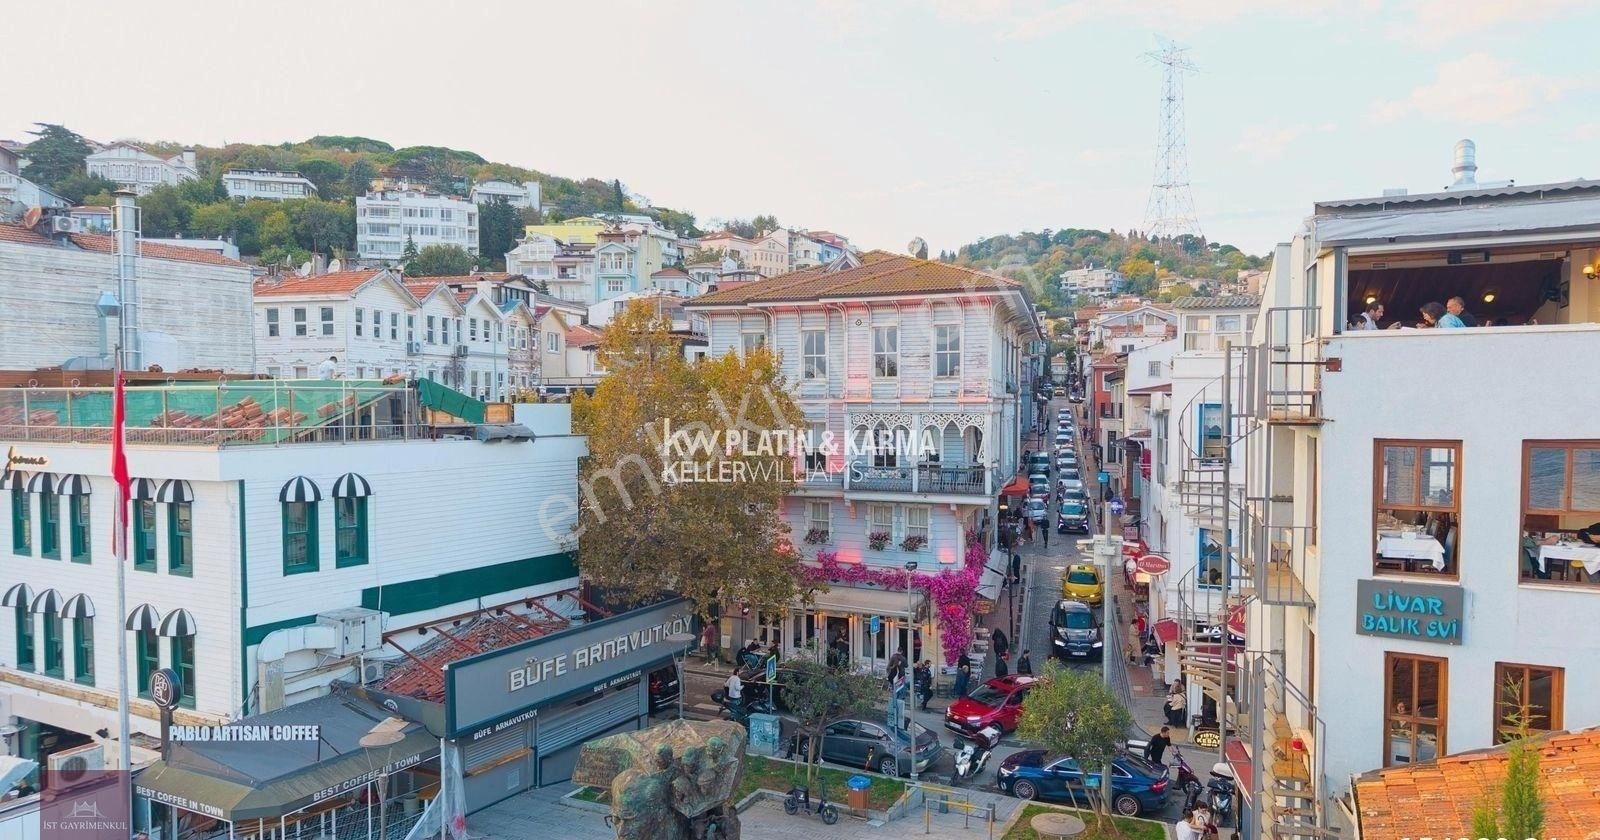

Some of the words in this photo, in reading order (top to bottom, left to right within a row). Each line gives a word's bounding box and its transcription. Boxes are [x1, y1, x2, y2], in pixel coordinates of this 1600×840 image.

[1374, 588, 1443, 616] LİVAR
[1362, 613, 1420, 636] BALIK
[509, 654, 568, 692] BÜFE
[574, 613, 693, 670] ARNAVUTKÖY
[169, 725, 211, 742] PABLO
[212, 725, 271, 742] ARTISAN
[273, 725, 319, 741] COFFEE
[313, 784, 340, 801] BEST
[343, 769, 380, 789] COFFEE
[395, 754, 420, 770] TOWN
[136, 786, 156, 798] BEST
[157, 792, 187, 807] COFFEE
[189, 800, 198, 810] IN
[199, 803, 224, 817] TOWN
